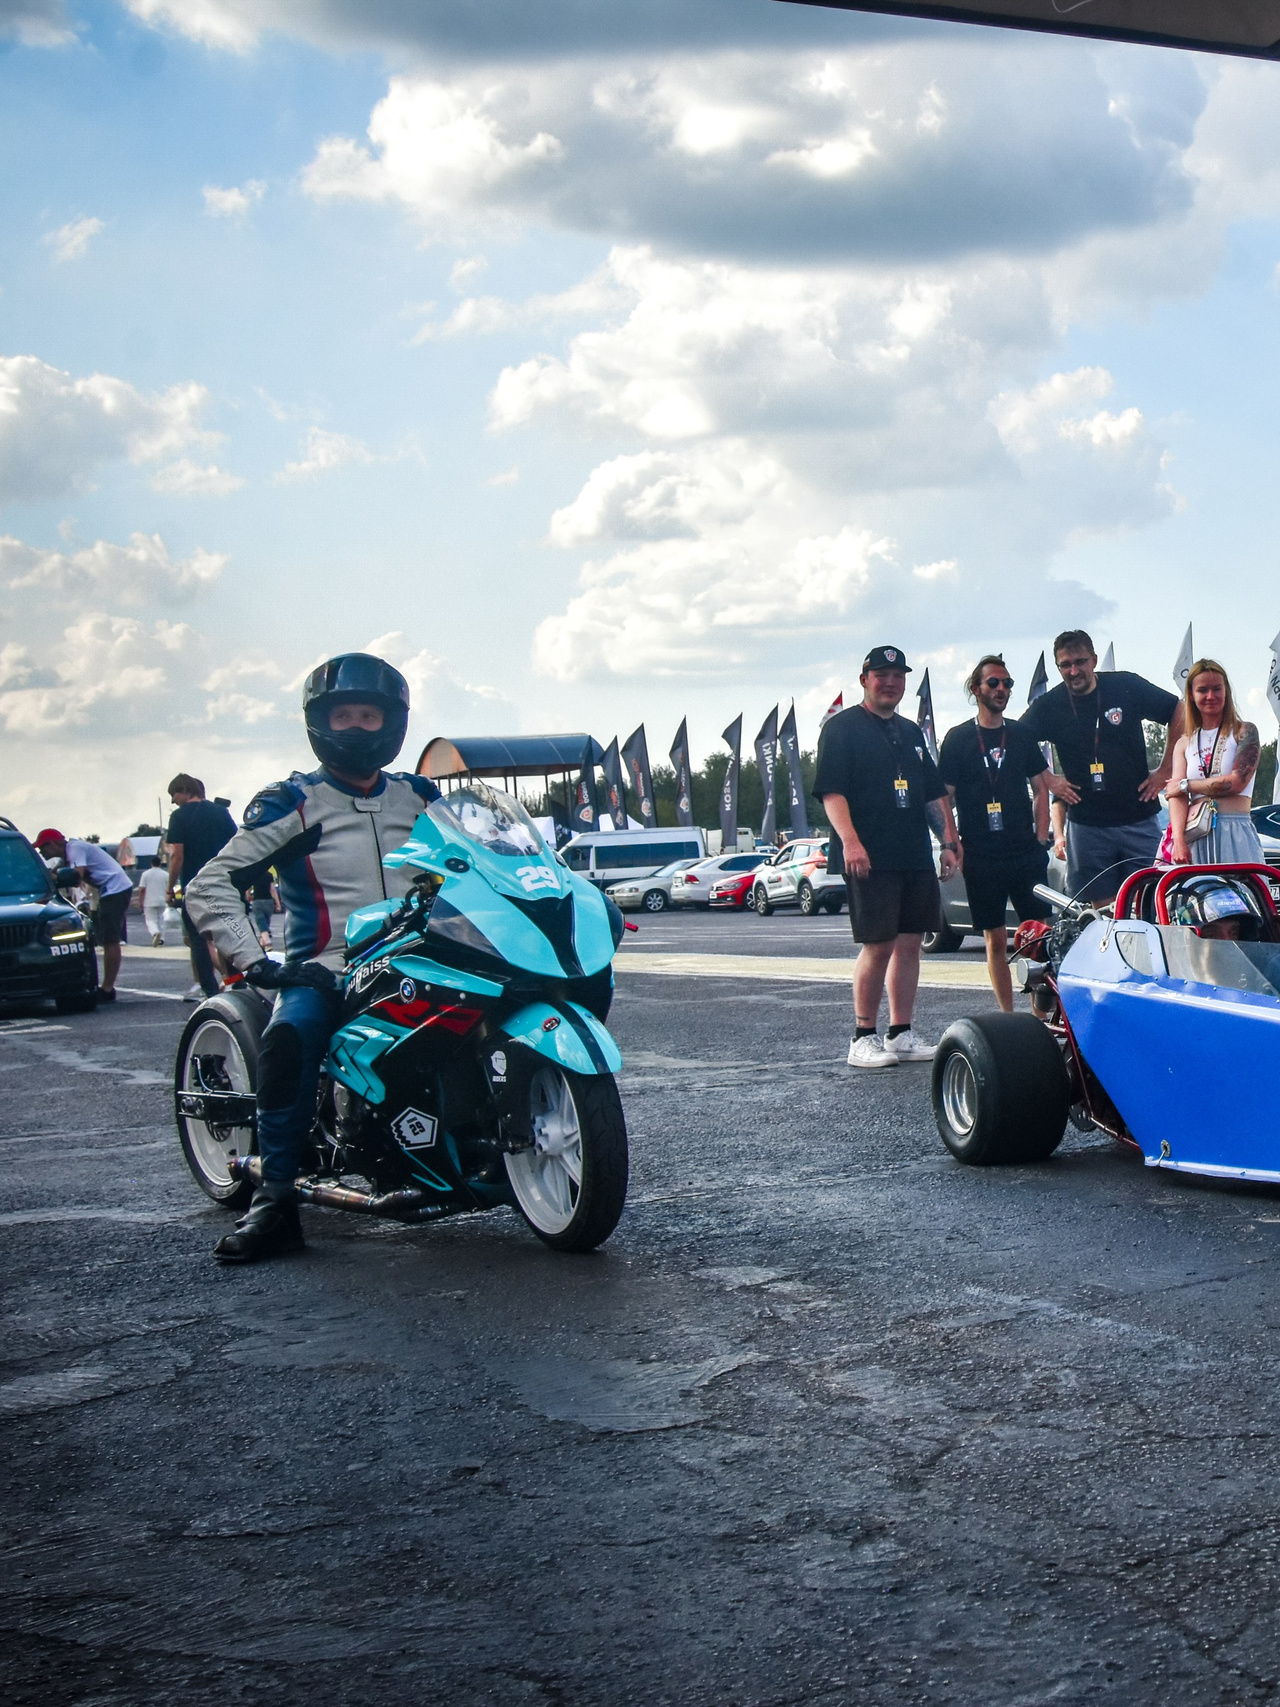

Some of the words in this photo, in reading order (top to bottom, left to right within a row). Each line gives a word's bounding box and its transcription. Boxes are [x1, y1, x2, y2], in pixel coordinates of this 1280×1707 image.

[515, 865, 561, 892] 29
[50, 942, 85, 956] RDRC
[408, 1121, 426, 1136] 29
